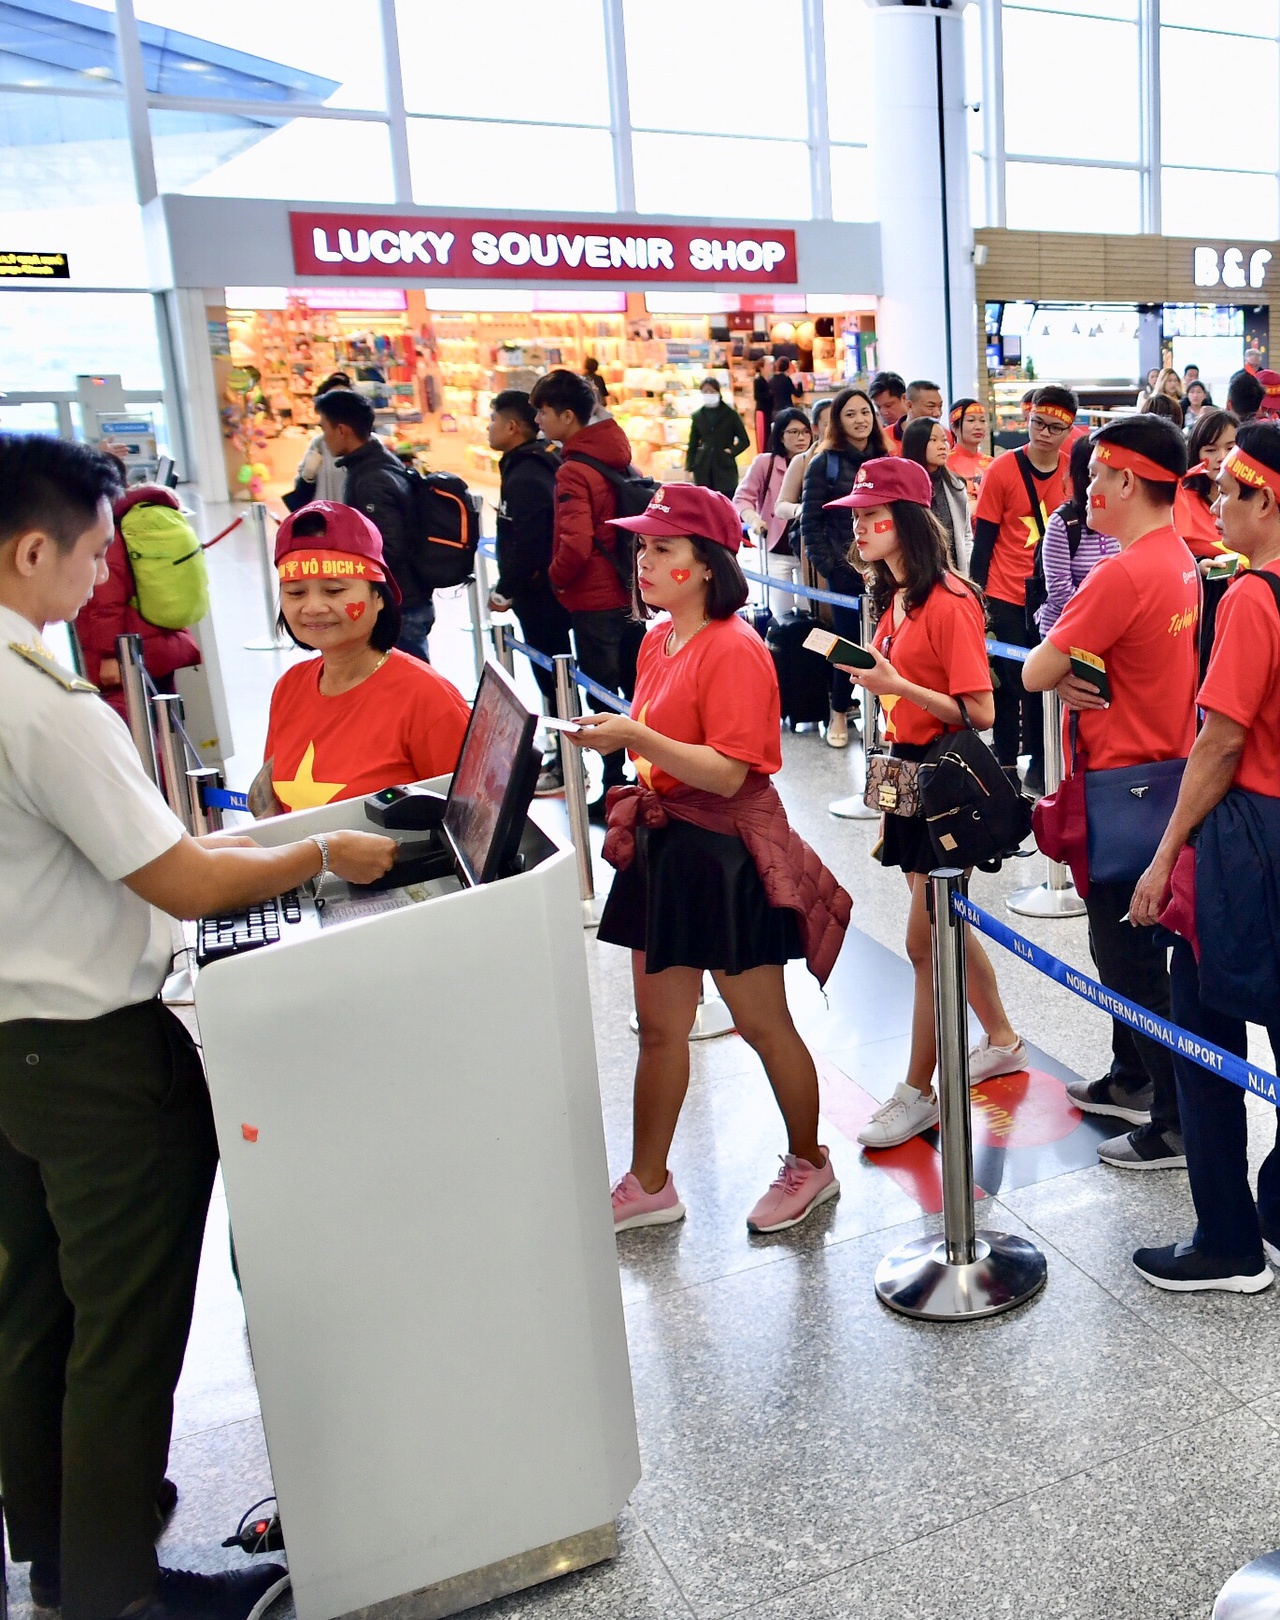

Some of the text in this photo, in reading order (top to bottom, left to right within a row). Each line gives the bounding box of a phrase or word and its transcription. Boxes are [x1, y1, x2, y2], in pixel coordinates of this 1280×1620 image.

[312, 227, 786, 272] LUCKY SOUVENIR SHOP
[301, 558, 319, 575] VÔ
[322, 560, 354, 577] ĐỊCH
[1013, 938, 1034, 960] N.I.A
[1065, 971, 1097, 1001] NOIBAI
[1098, 990, 1175, 1046] INTERNATIONAL
[1177, 1035, 1223, 1071] AIRPORT
[1248, 1071, 1277, 1101] N.I.A
